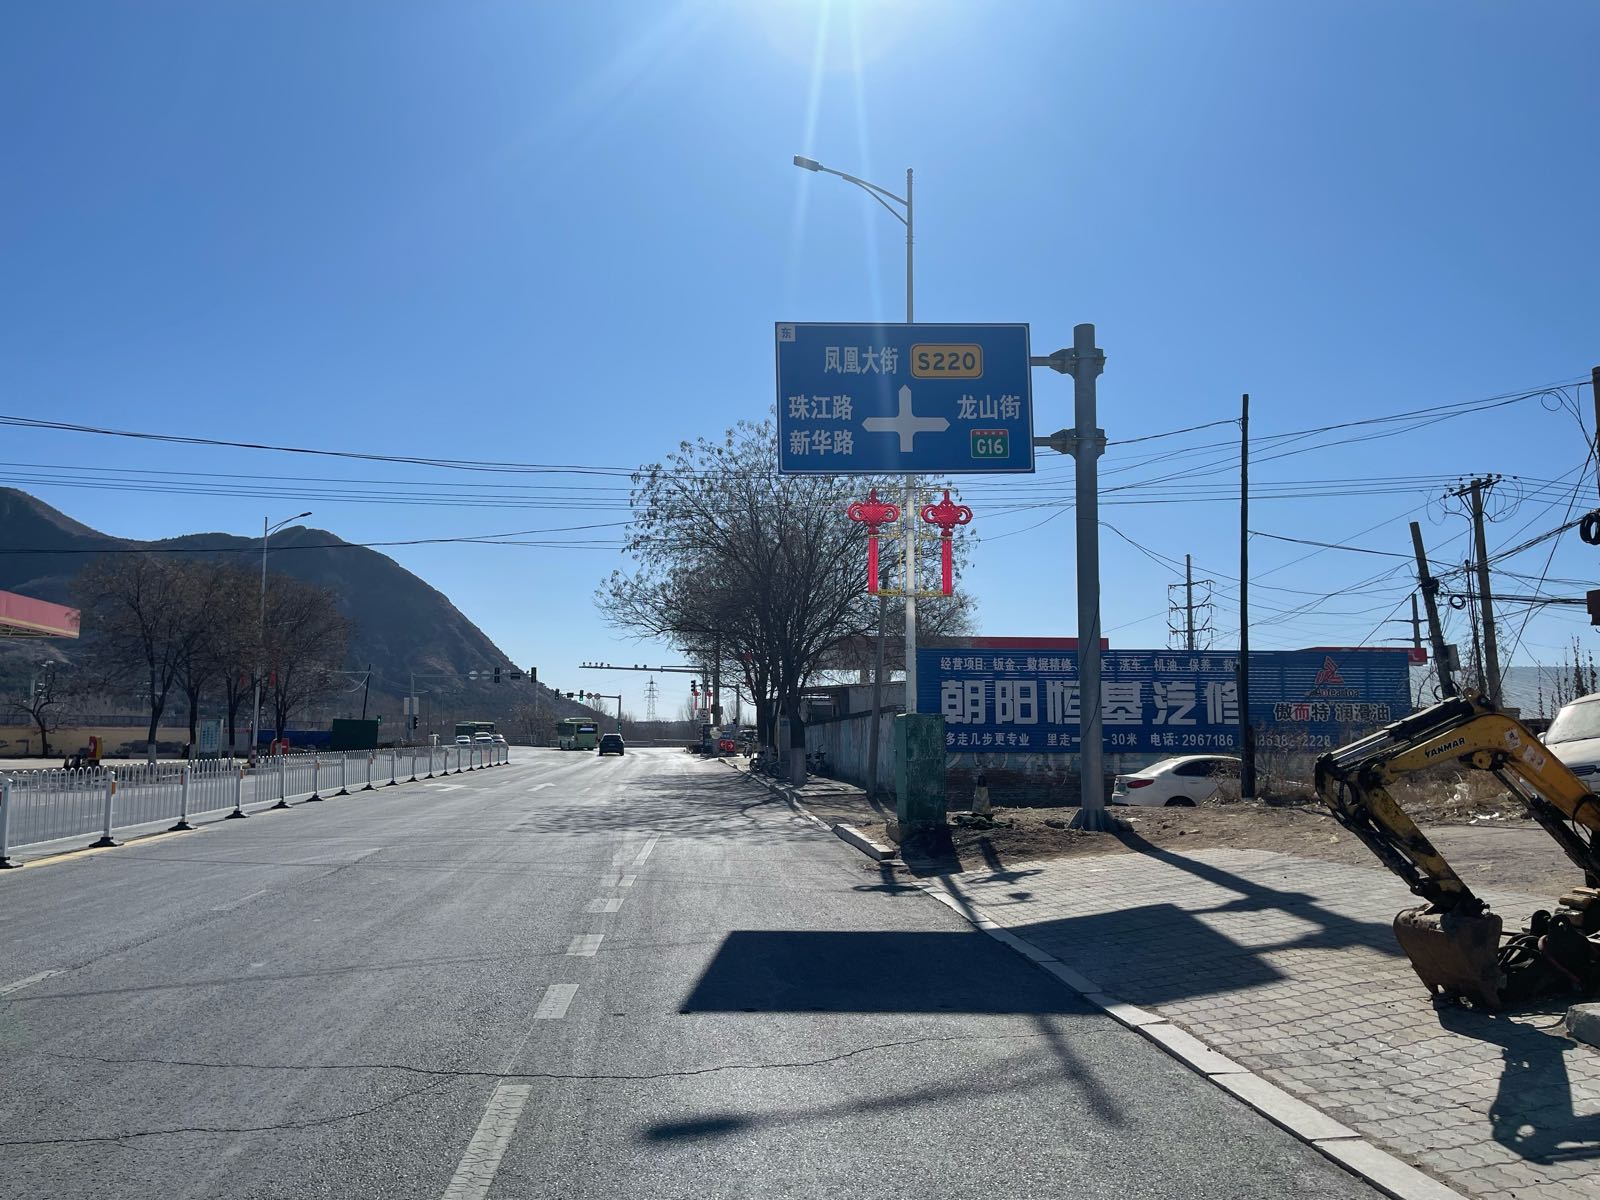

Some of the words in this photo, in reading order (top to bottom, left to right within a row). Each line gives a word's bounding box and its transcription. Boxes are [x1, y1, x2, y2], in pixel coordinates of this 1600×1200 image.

[780, 327, 792, 339] 东
[824, 345, 899, 375] 凤凰大街
[918, 352, 976, 371] S220
[788, 394, 853, 421] 珠江路
[956, 394, 1021, 420] 龙山街
[789, 429, 854, 456] 新华路
[976, 438, 1004, 455] G16
[1335, 702, 1391, 722] 润滑油
[945, 732, 1030, 746] 多走几步更专业
[1424, 737, 1465, 758] YANMAR
